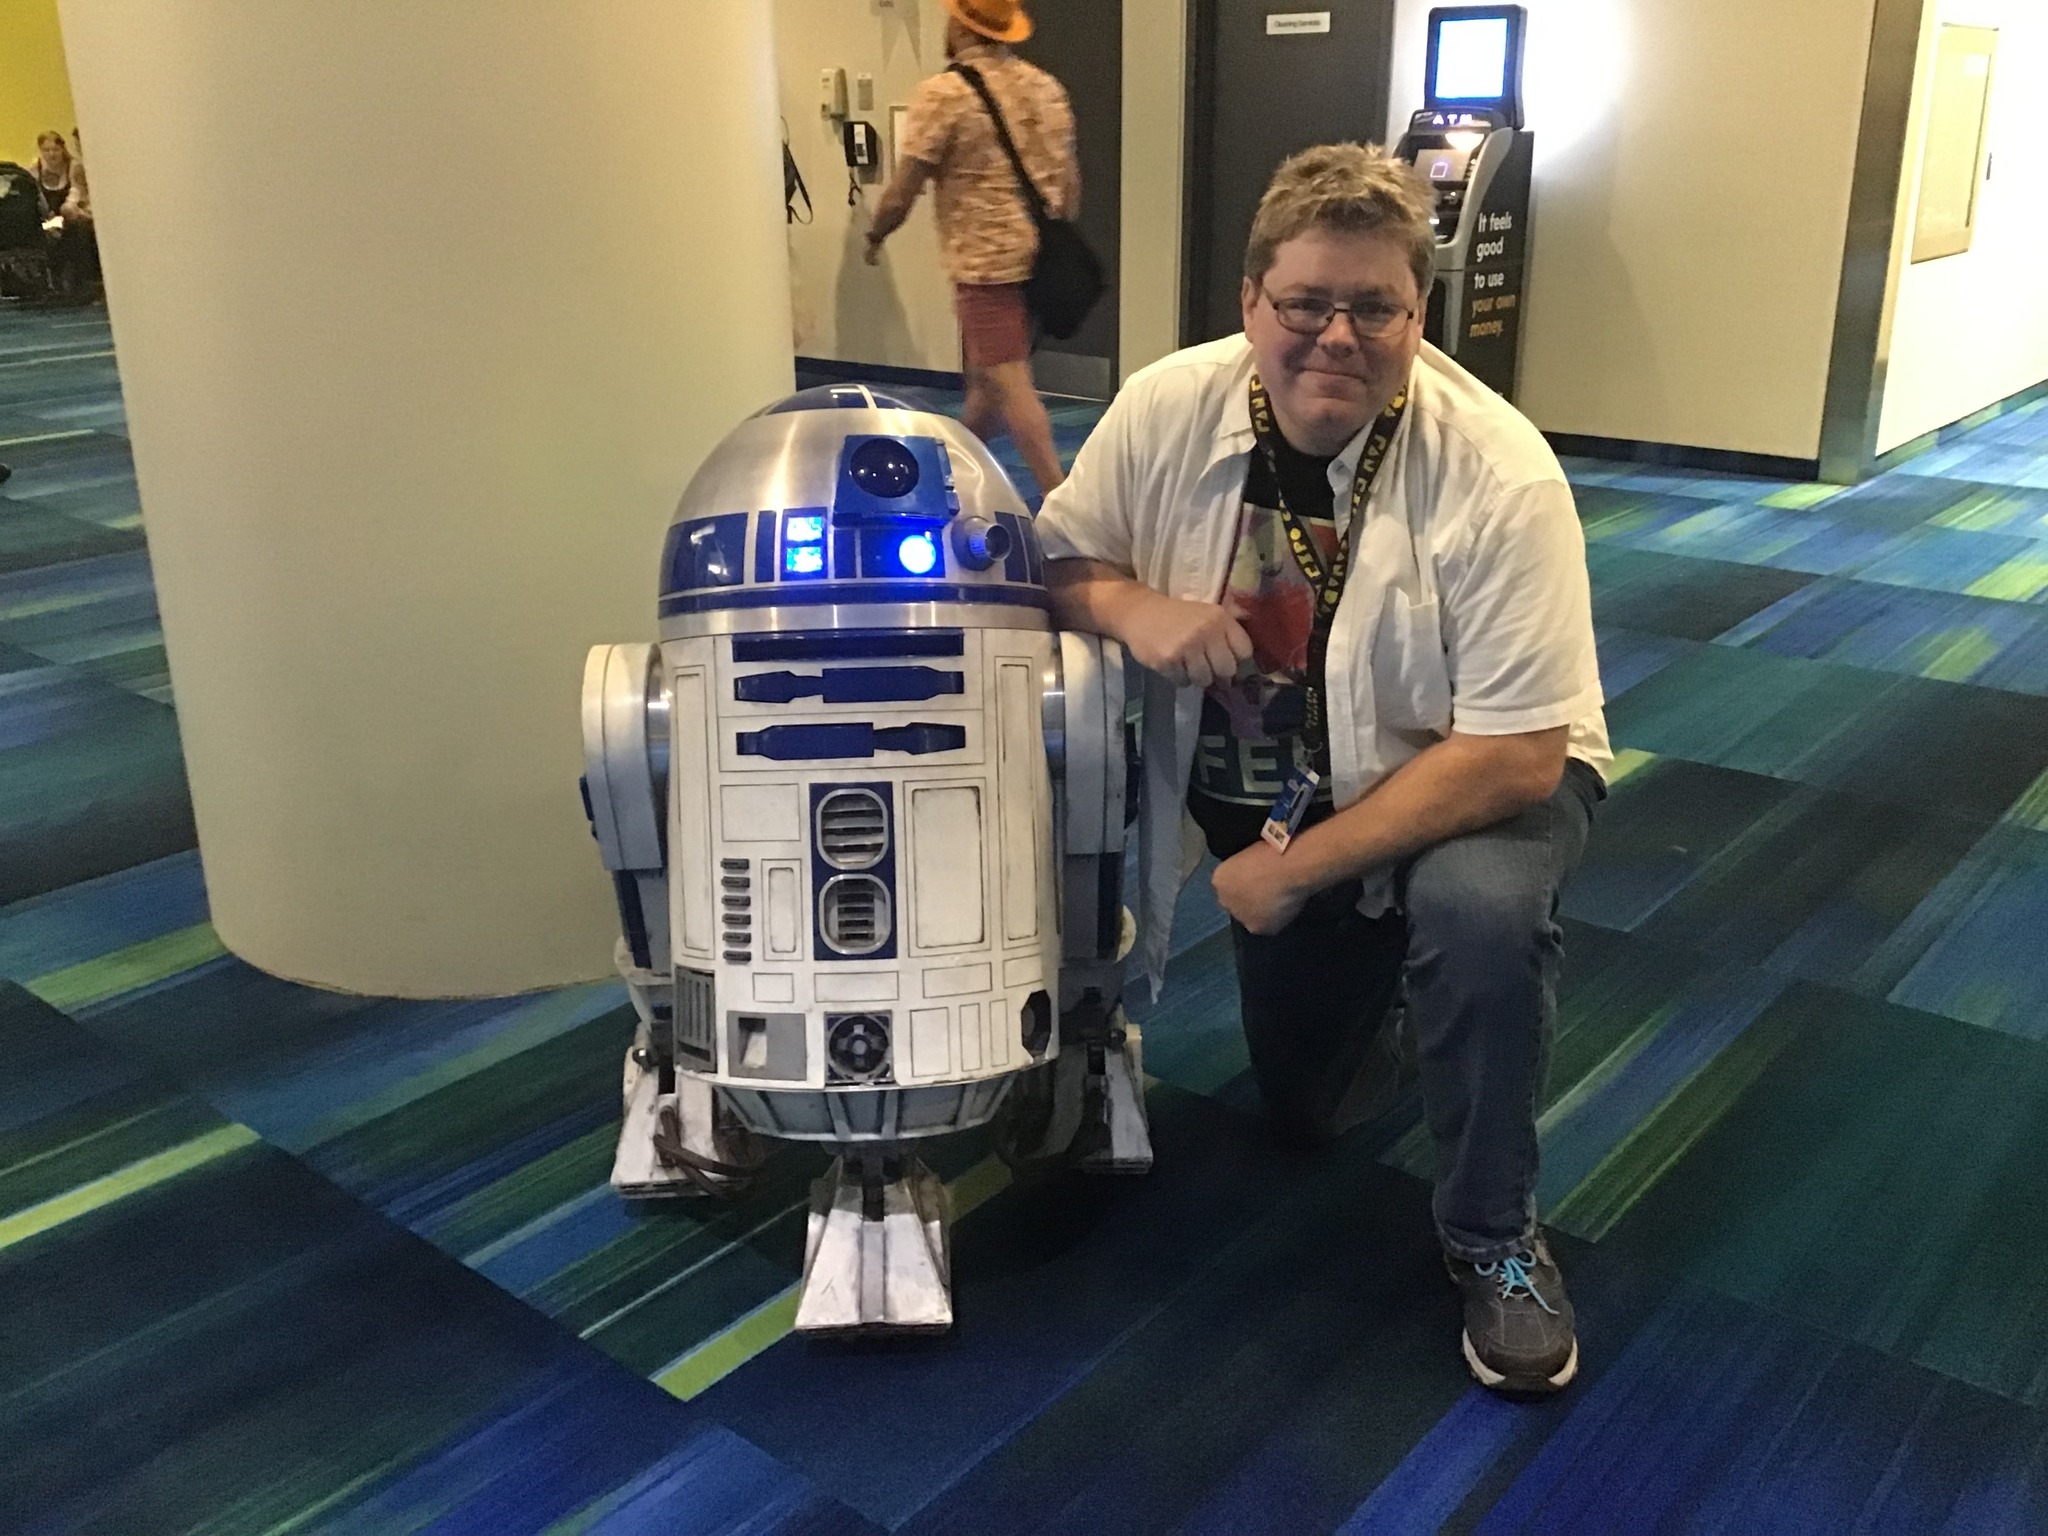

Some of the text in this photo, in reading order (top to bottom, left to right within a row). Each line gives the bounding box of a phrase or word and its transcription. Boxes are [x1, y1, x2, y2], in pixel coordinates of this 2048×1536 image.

[1433, 113, 1472, 125] ATM
[1478, 211, 1512, 232] It feels
[1476, 236, 1504, 262] good
[1474, 272, 1504, 289] to use
[1471, 297, 1494, 318] your
[1363, 434, 1387, 473] FAN
